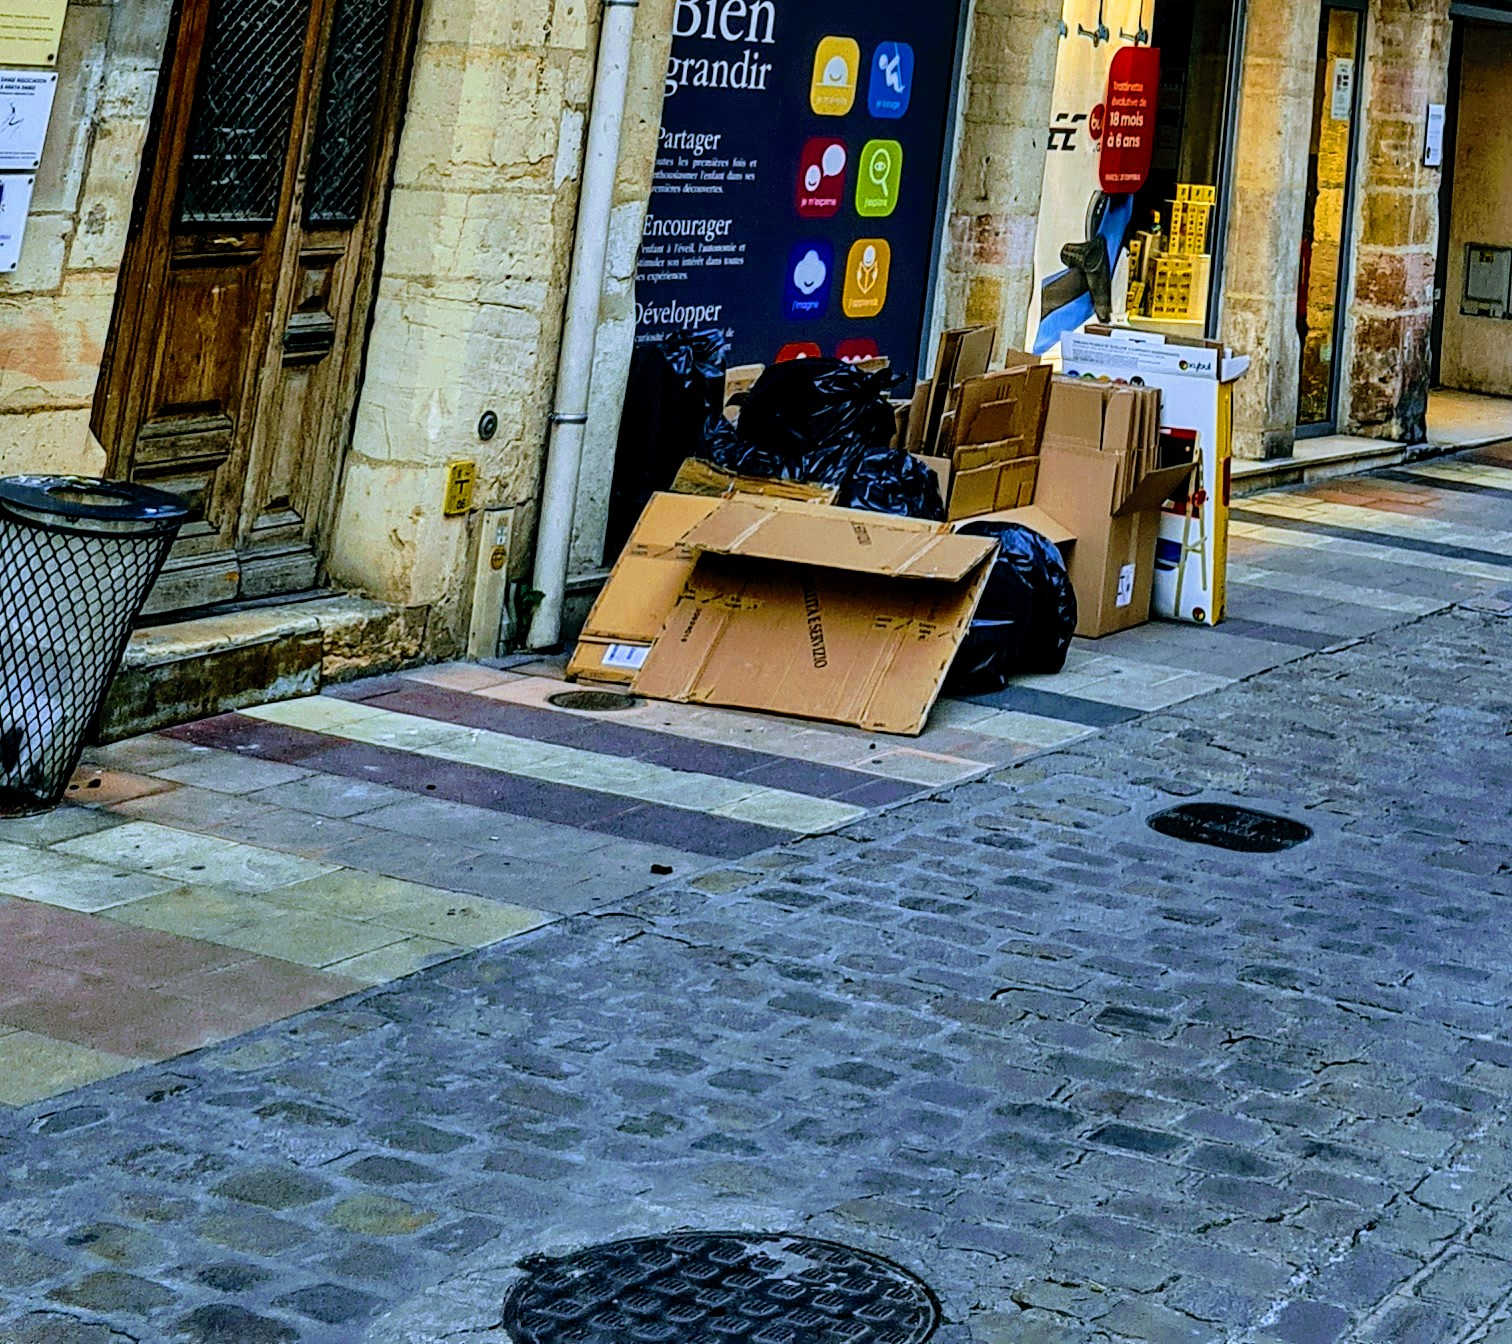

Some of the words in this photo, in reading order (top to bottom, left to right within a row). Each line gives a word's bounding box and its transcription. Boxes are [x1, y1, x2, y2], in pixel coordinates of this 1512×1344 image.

[664, 49, 773, 98] grandir
[1109, 111, 1120, 127] 18
[1120, 111, 1144, 127] mois
[1106, 132, 1114, 148] à
[1115, 133, 1122, 148] 6
[1122, 135, 1141, 148] ans
[642, 214, 733, 242] Encourager
[635, 299, 722, 330] Développer
